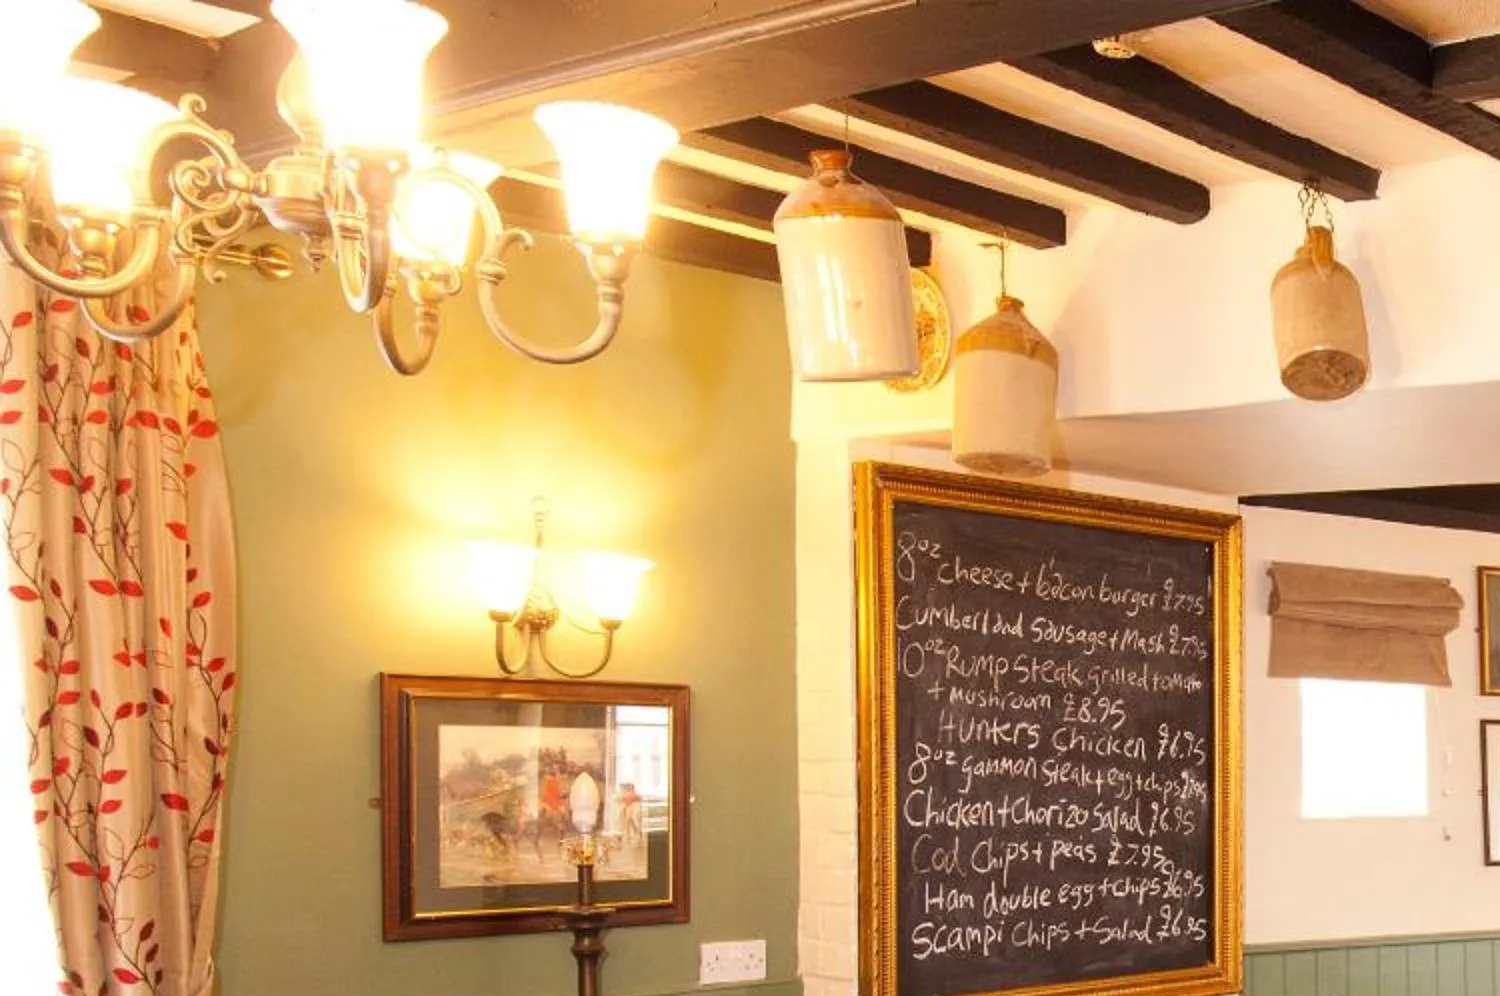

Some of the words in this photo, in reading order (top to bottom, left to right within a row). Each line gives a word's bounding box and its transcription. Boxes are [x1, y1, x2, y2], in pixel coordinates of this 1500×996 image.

[1036, 560, 1094, 600] bacon
[1099, 573, 1156, 616] burger
[1031, 617, 1106, 654] Sausage
[1120, 628, 1165, 653] Mash
[946, 645, 1009, 692] Rump
[1013, 653, 1082, 688] Steak
[1088, 663, 1149, 695] grilled
[928, 680, 945, 700] +
[1063, 692, 1127, 731] £8.95
[938, 708, 1041, 749] Hunters
[1051, 727, 1147, 762] Chicken
[1157, 722, 1206, 767] £6.95
[1041, 759, 1095, 788] Steak
[1107, 767, 1133, 800] egg
[904, 789, 995, 830] Chicken
[1091, 797, 1145, 836] Salad
[1148, 801, 1195, 837] £6.95
[911, 834, 967, 877] Cod
[971, 841, 1029, 889] Chips
[1107, 833, 1165, 870] £7.95
[925, 882, 975, 914] Ham
[984, 881, 1051, 919] double
[1058, 883, 1094, 910] egg
[911, 920, 1006, 961] Scampi
[1011, 920, 1070, 951] Chips
[1093, 915, 1153, 945] Salad
